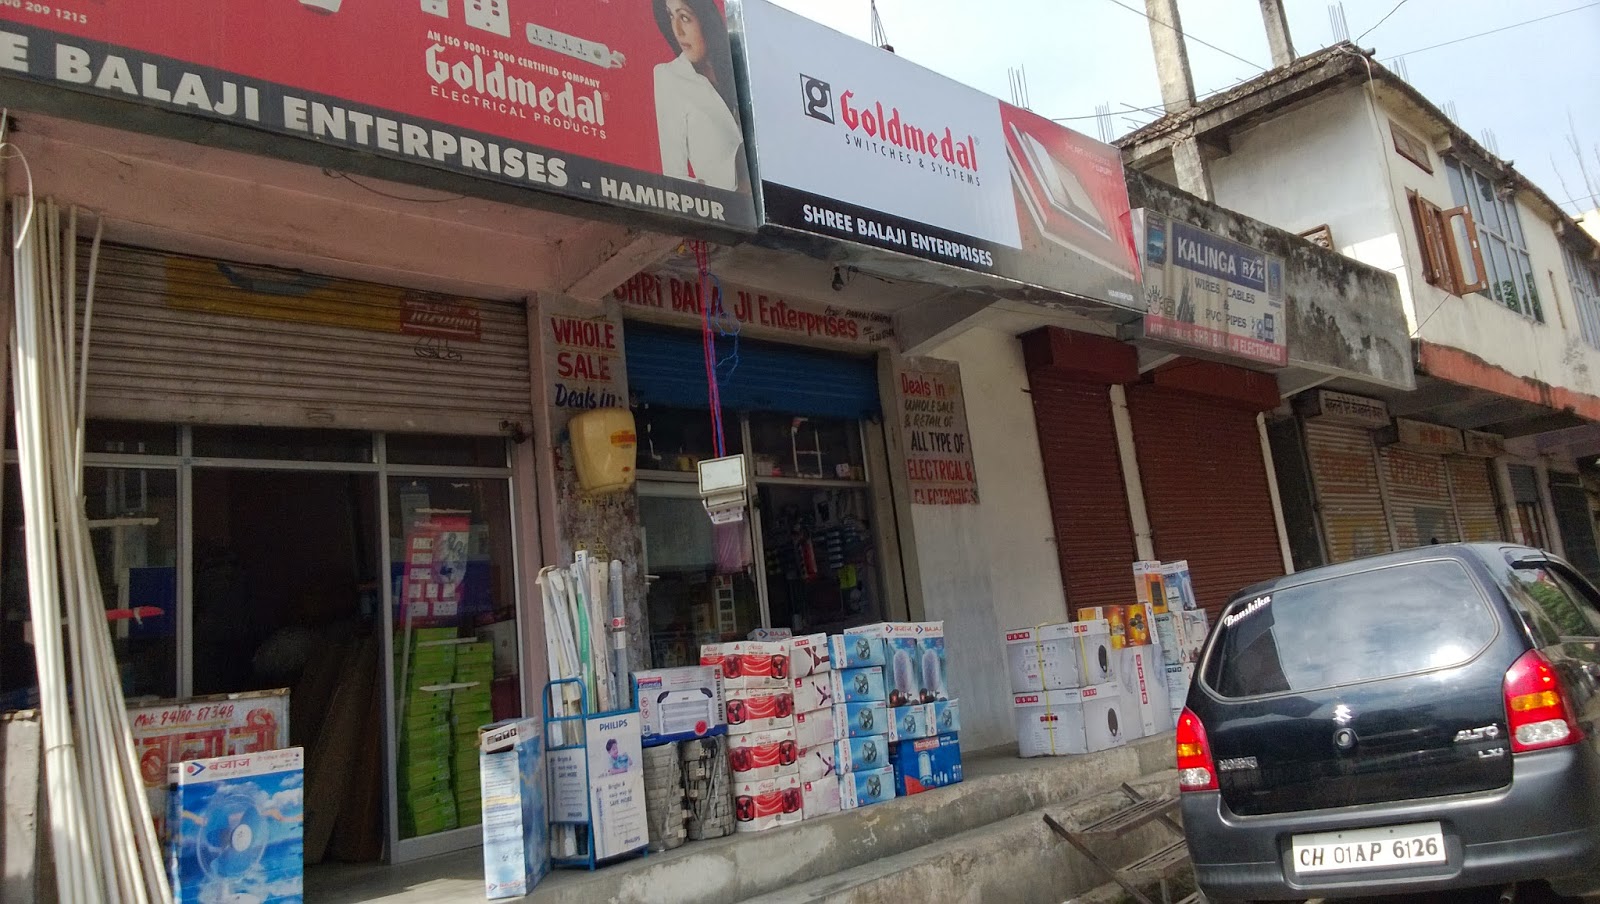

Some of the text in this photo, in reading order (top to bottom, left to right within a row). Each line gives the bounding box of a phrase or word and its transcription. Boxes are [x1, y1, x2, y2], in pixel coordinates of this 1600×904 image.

[25, 1, 51, 15] 209
[56, 8, 88, 24] 1215
[427, 30, 442, 42] AN
[444, 34, 461, 48] ISO
[493, 47, 516, 63] 2000
[518, 55, 560, 77] CERTIFIED
[561, 69, 601, 89] COMPANY
[425, 43, 605, 127] Goldmedal
[431, 85, 608, 140] ELECTRICAL PRODUCTS
[55, 43, 260, 122] BALAJI
[283, 95, 569, 187] ENTERPRISES
[600, 176, 726, 221] HAMIRPUR
[840, 89, 978, 172] Goldmedal
[845, 133, 981, 187] SWITCHES & SYSTEMS
[803, 204, 993, 267] SHREE BALAJI ENTERPRISES
[1177, 236, 1237, 276] KALINGA
[1226, 287, 1256, 305] CABLES
[734, 290, 754, 324] JI
[758, 294, 858, 341] Enterprises
[1205, 308, 1222, 322] PVC
[1225, 313, 1247, 329] PIPES
[551, 317, 616, 349] WHOLE
[557, 352, 612, 381] SALE
[555, 383, 597, 409] Deals
[900, 373, 932, 396] Deals
[914, 414, 942, 429] RETAIL
[911, 430, 965, 454] ALL TYPE OF
[906, 459, 965, 481] ELECTRICAL
[1224, 595, 1272, 627] Banshika
[599, 718, 629, 732] PHILIPS
[1453, 725, 1499, 742] ALTO
[208, 758, 251, 771] बजाज
[1300, 837, 1439, 866] CH 01AP 6126
